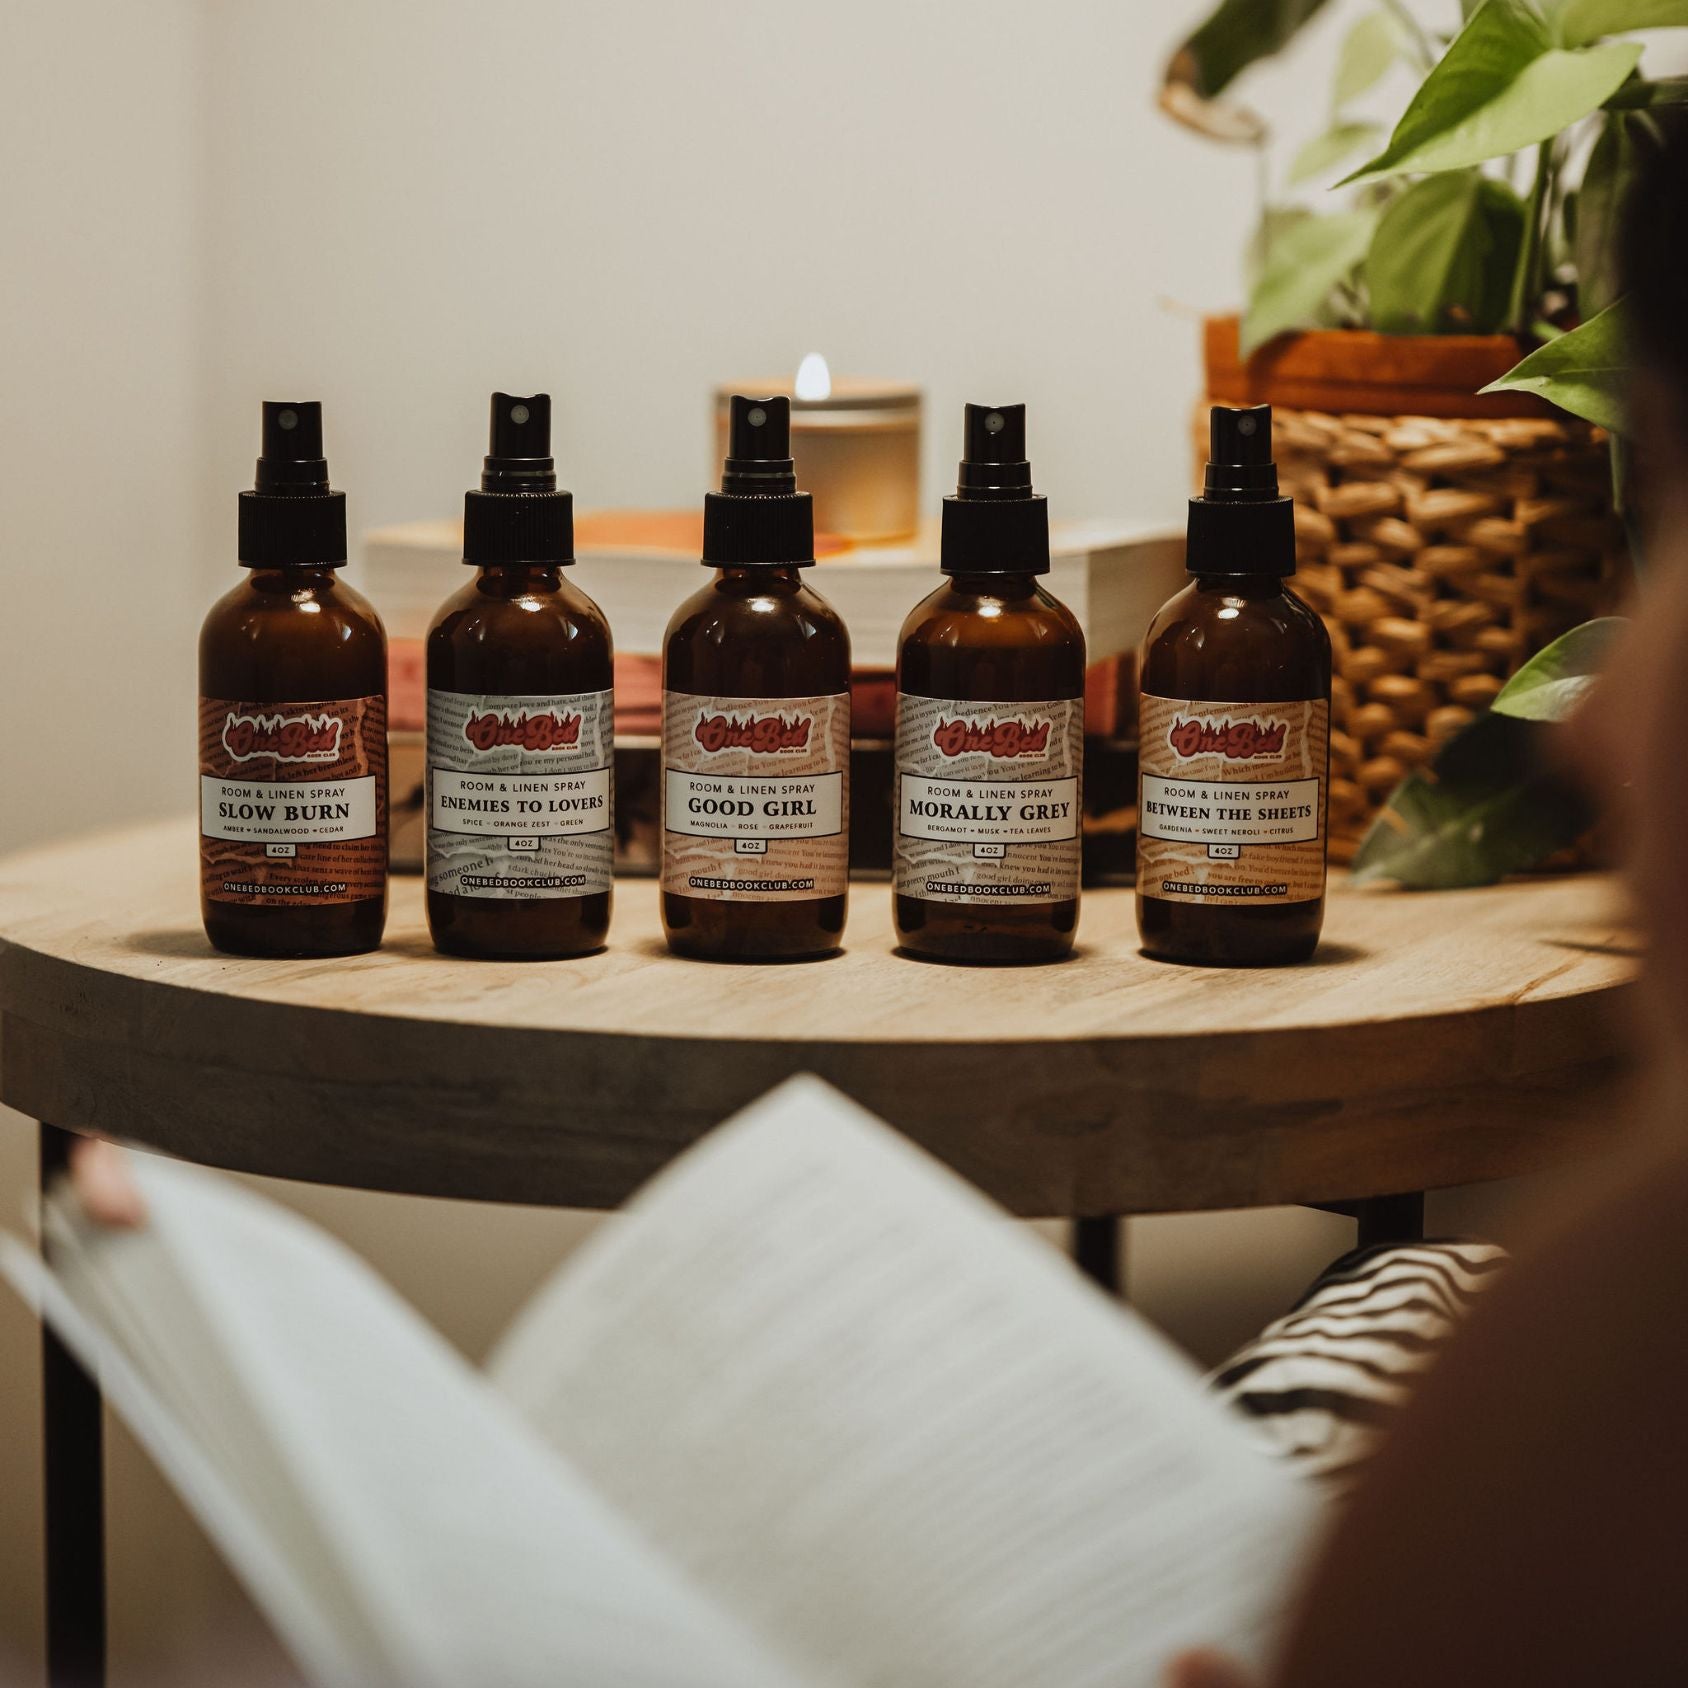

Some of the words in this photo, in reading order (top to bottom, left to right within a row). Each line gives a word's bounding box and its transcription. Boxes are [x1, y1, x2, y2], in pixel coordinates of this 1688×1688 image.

[556, 752, 584, 764] personal
[781, 762, 813, 775] learning
[1021, 767, 1051, 780] learning
[1221, 765, 1250, 777] Which
[460, 780, 494, 791] ROOM
[499, 783, 507, 792] &
[512, 783, 549, 792] LINEN
[554, 781, 586, 791] SPRAY
[689, 781, 721, 793] ROOM
[727, 785, 735, 793] &
[740, 785, 776, 795] LINEN
[781, 784, 815, 794] SPRAY
[222, 787, 250, 798] ROOM
[256, 790, 263, 798] &
[268, 790, 305, 799] LINEN
[310, 787, 346, 798] SPRAY
[927, 786, 961, 798] ROOM
[966, 789, 974, 798] &
[979, 790, 1016, 799] LINEN
[1021, 789, 1053, 798] SPRAY
[1164, 786, 1196, 798] ROOM
[1200, 790, 1208, 799] &
[1213, 791, 1250, 800] LINEN
[1256, 790, 1290, 800] SPRAY
[441, 795, 510, 812] ENEMIES
[517, 800, 542, 812] TO
[549, 795, 603, 812] LOVERS
[688, 797, 754, 816] GOOD
[763, 799, 817, 817] GIRL
[219, 802, 275, 821] SLOW
[284, 803, 350, 821] BURN
[909, 799, 1012, 821] MORALLY
[1020, 802, 1070, 820] GREY
[1146, 801, 1210, 820] BETWEEN
[1216, 808, 1252, 820] THE
[1258, 804, 1312, 820] SHEETS
[224, 825, 244, 833] AMBER
[462, 818, 483, 826] SPICE
[493, 820, 528, 828] ORANGE
[531, 820, 550, 828] ZEST
[560, 819, 584, 827] GREEN
[690, 820, 728, 829] MAGNOLIA
[769, 822, 813, 830] GRAPEFRUIT
[927, 824, 967, 833] BERGAMOT
[1027, 826, 1051, 834] LEAVES
[1159, 824, 1192, 833] GARDENIA
[271, 846, 290, 854] 4OZ
[741, 842, 760, 850] 4OZ
[439, 859, 484, 881] someone
[690, 863, 717, 876] mouth
[927, 868, 955, 881] mouth
[1022, 865, 1036, 874] you
[460, 875, 586, 887] ONEBEDBOOKCLUB.COM
[976, 872, 996, 882] good
[223, 882, 346, 894] ONEBEDBOOKCLUB.COM
[689, 878, 814, 890] ONEBEDBOOKCLUB.COM
[926, 882, 1050, 895] ONEBEDBOOKCLUB.COM
[1163, 883, 1287, 895] ONEBEDBOOKCLUB.COM
